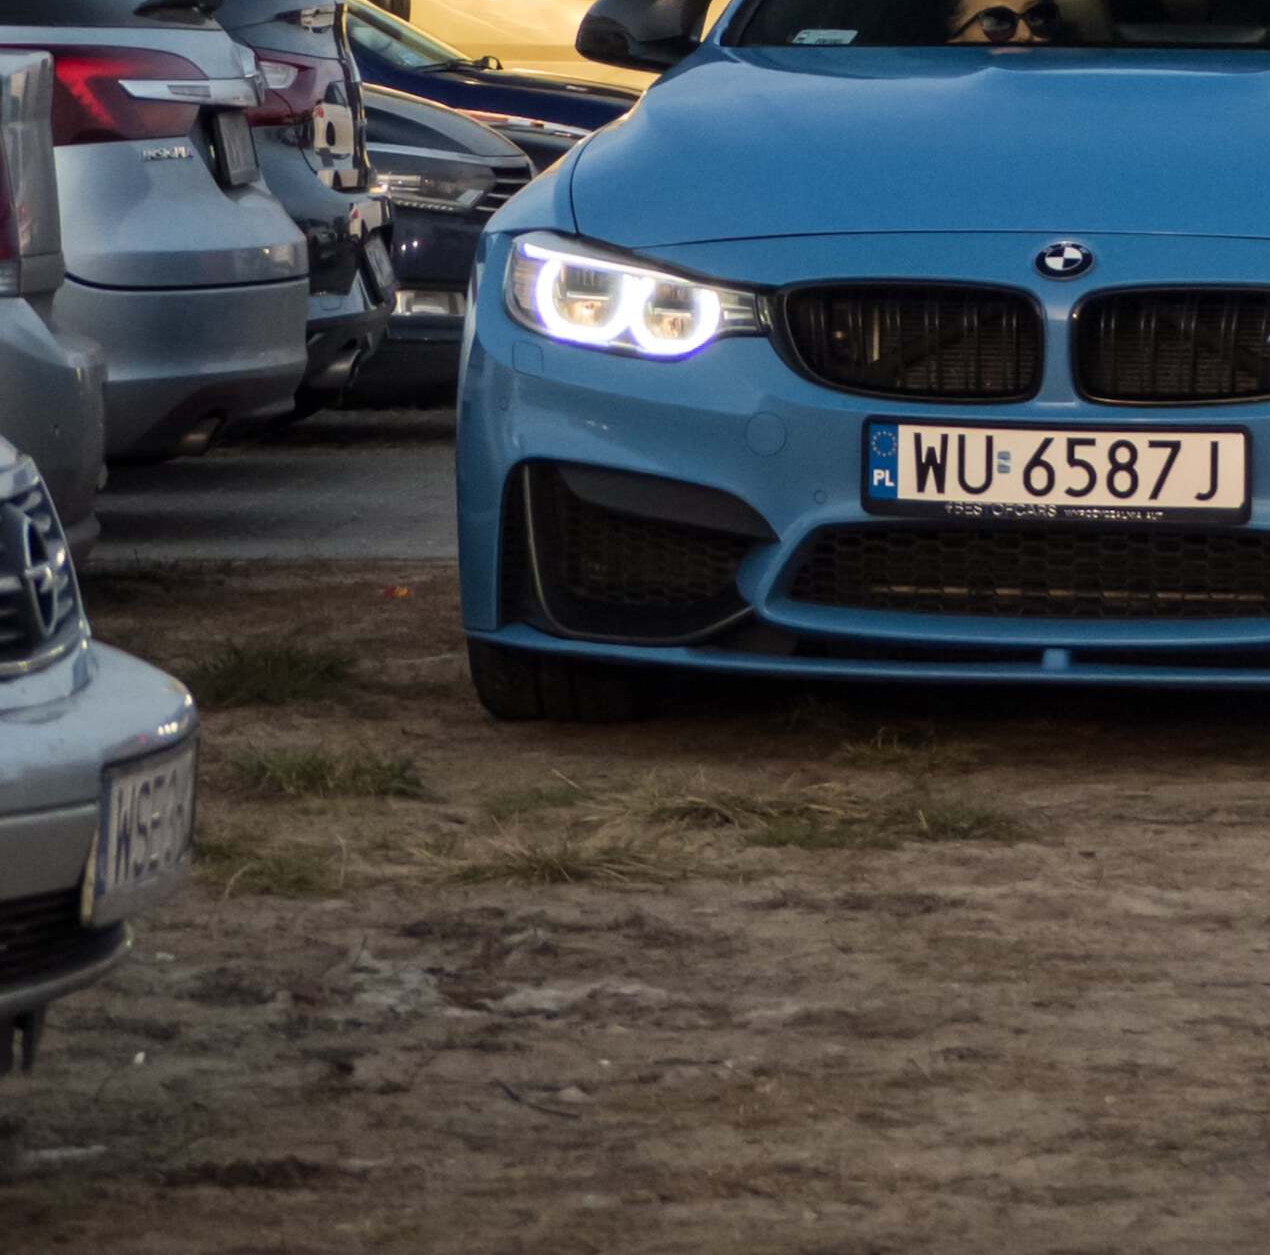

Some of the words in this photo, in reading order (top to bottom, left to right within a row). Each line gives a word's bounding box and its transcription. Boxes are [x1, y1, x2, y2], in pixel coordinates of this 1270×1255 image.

[872, 470, 895, 487] PL
[913, 432, 994, 496] WU
[1022, 436, 1220, 502] 6587J
